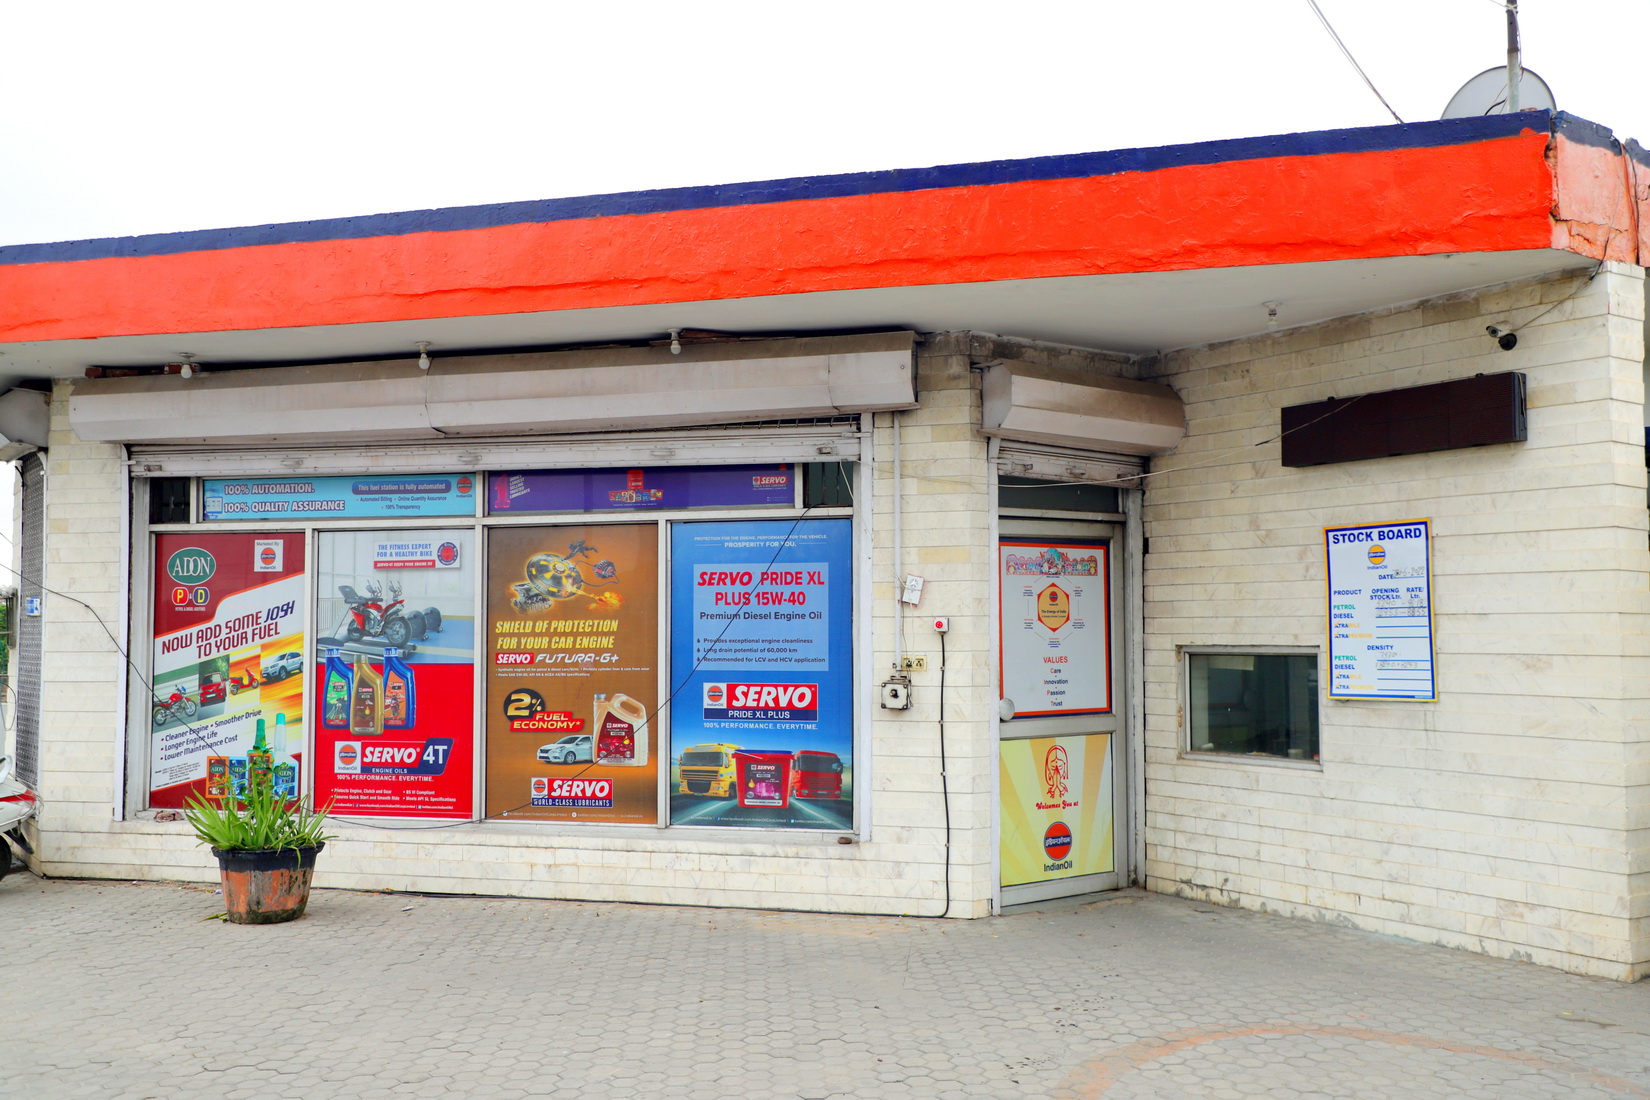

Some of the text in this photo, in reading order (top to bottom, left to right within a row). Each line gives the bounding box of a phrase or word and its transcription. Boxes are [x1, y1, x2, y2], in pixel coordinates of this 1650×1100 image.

[405, 483, 416, 491] fully
[760, 476, 786, 484] SERVO
[224, 482, 316, 495] 100% AUTOMATION.
[224, 500, 345, 513] 100% QUALITY ASSURANCE
[1332, 527, 1422, 544] STOCK BOARD
[172, 556, 211, 576] ADON
[697, 571, 825, 586] SERVO PRIDE XL
[176, 589, 205, 603] P D
[714, 591, 807, 606] PLUS 15W-40
[699, 611, 822, 621] Premium Diesel Engine Oil
[162, 600, 295, 655] NOW ADD SOME JOSH
[495, 619, 619, 633] SHIELD OF PROTECTION
[196, 621, 280, 659] TO YOUR FUEL
[497, 636, 615, 649] FOR YOUR CAR ENGINE
[496, 653, 619, 664] SERVO FUTURA-G+
[731, 685, 812, 708] SERVO
[507, 692, 542, 716] 2%
[536, 712, 569, 721] FUEL
[728, 710, 790, 719] PRIDE XL PLUS
[165, 709, 262, 742] Cleaner Engine Smoother Drive
[164, 730, 218, 752] Longer Engine Life
[164, 734, 238, 761] Lower Maintenance Cost
[363, 745, 448, 764] SERVO 4T
[550, 779, 609, 798] SERVO
[574, 799, 610, 807] LUBRICANTS
[1036, 802, 1060, 810] Welcomes
[1043, 860, 1073, 872] IndianOil
